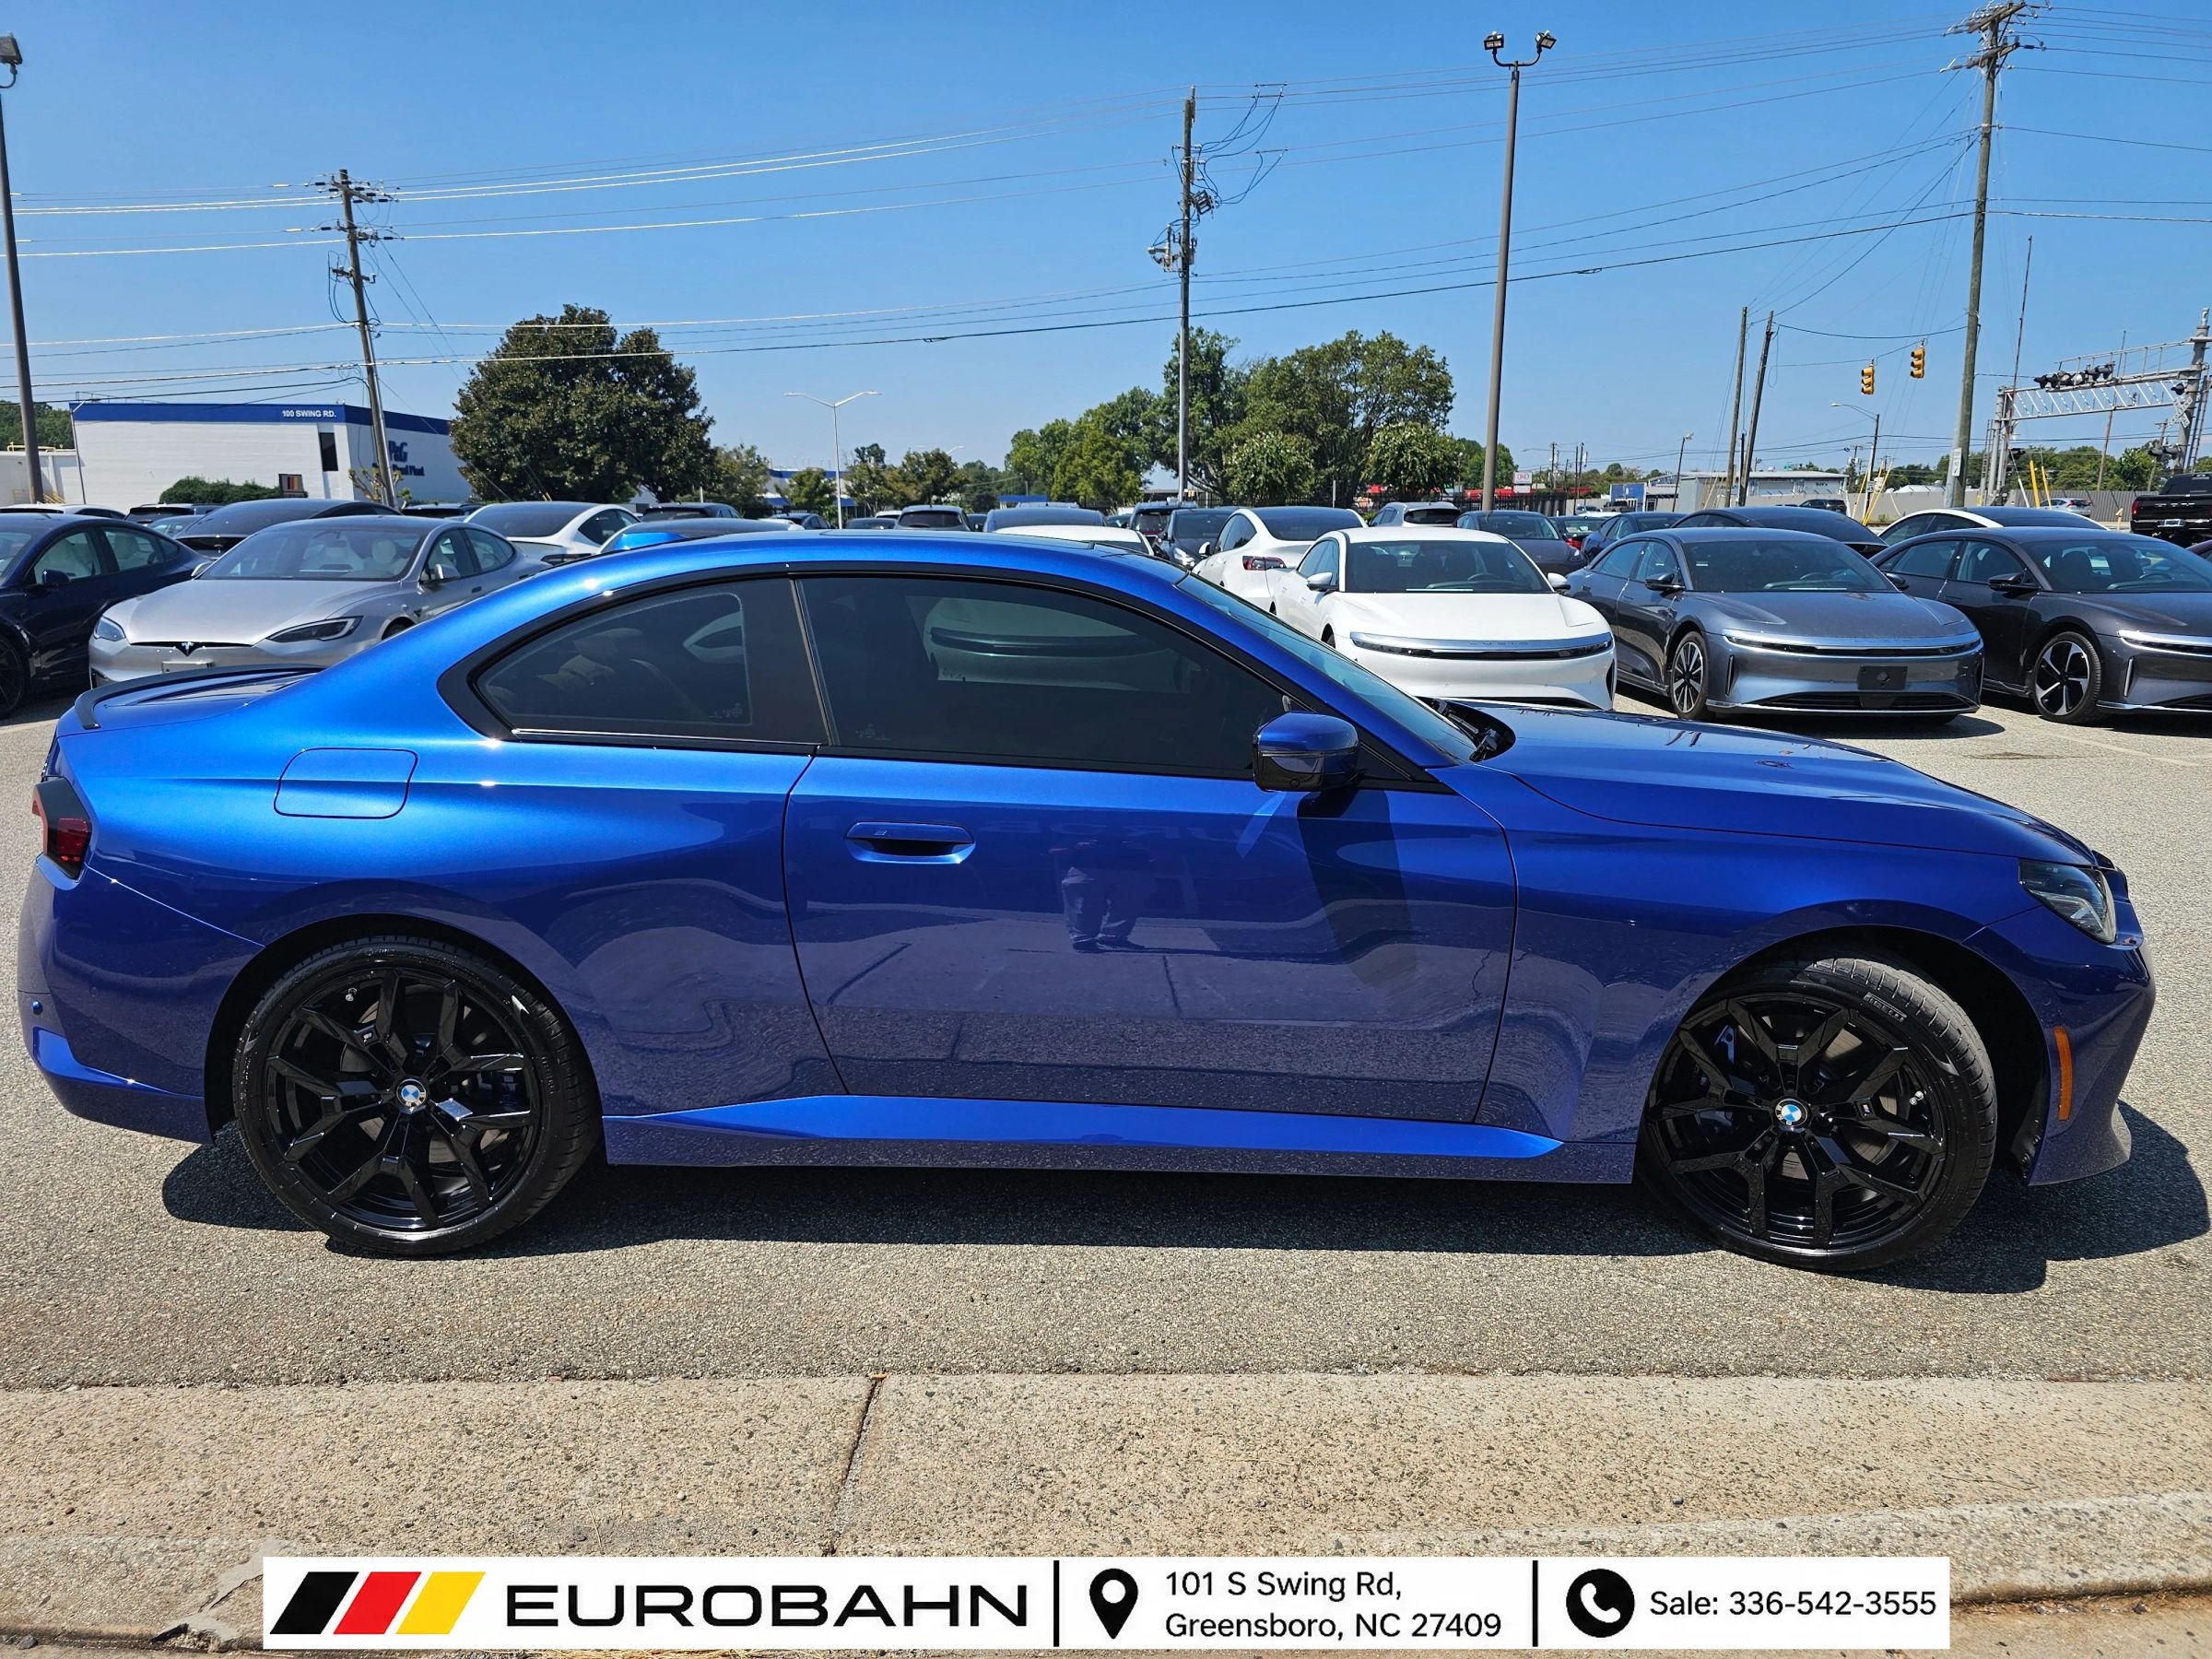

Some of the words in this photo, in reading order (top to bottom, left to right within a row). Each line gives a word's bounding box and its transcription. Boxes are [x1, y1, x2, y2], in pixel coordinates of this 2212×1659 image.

[282, 409, 295, 418] 100
[295, 409, 322, 418] SWING
[323, 409, 337, 418] RD.
[388, 441, 408, 463] P&G
